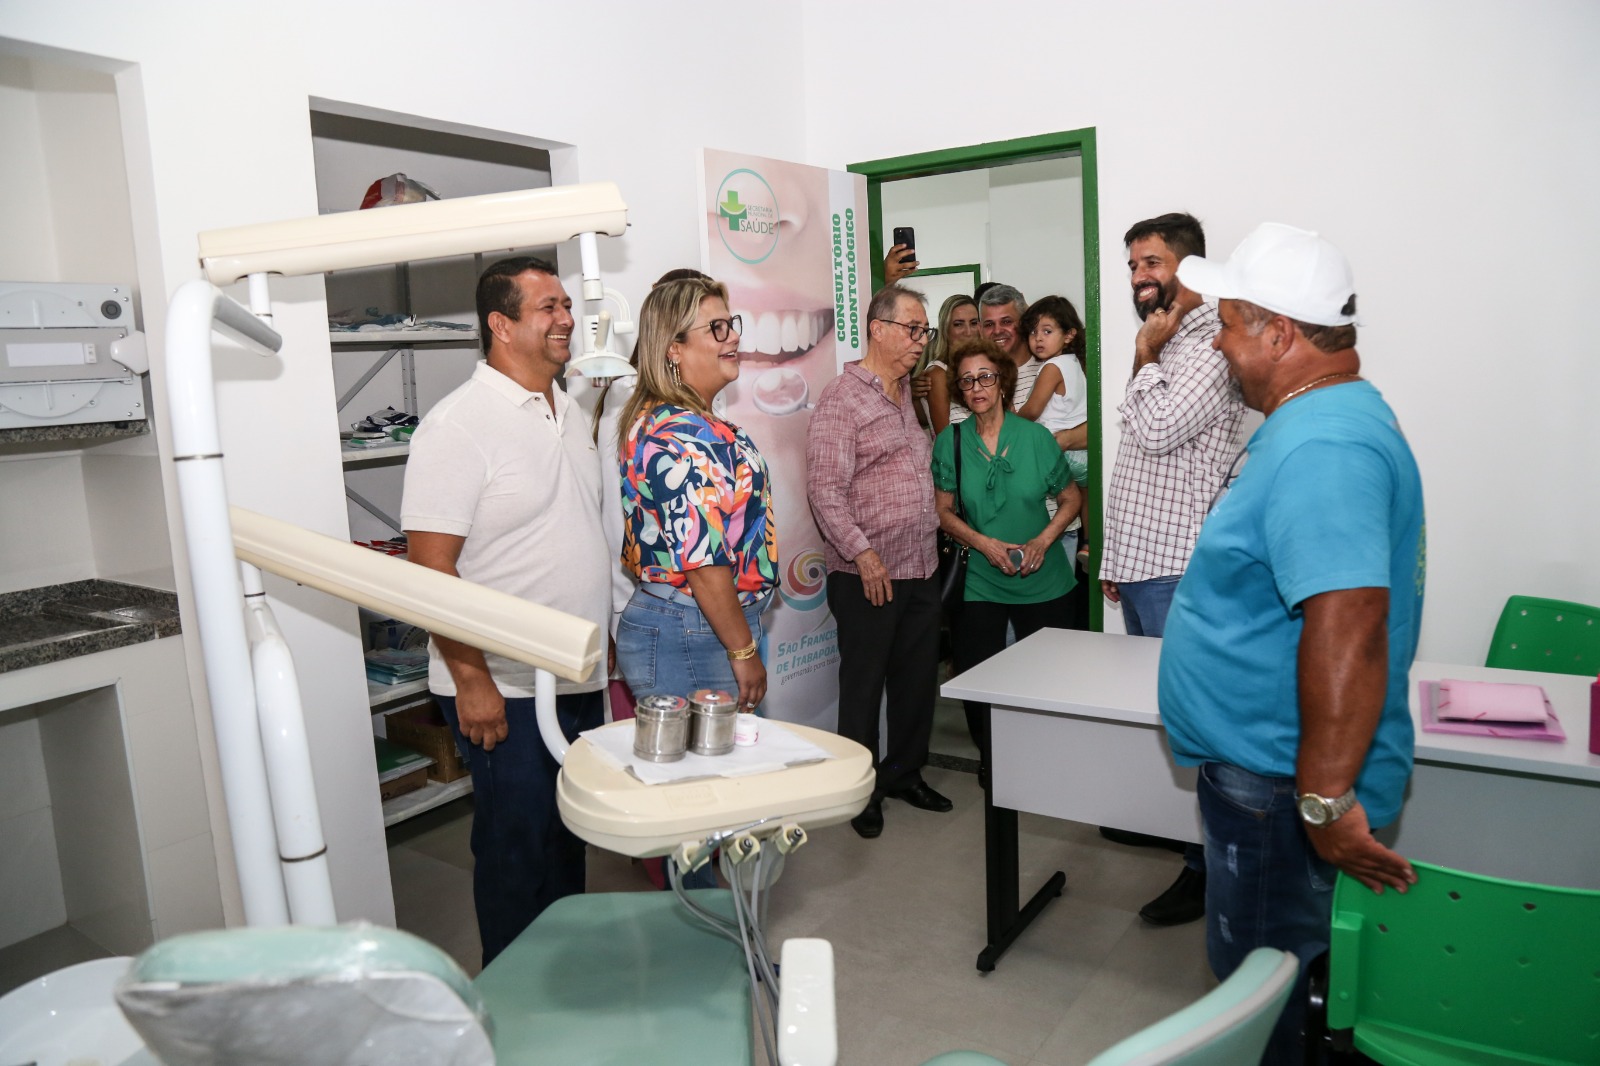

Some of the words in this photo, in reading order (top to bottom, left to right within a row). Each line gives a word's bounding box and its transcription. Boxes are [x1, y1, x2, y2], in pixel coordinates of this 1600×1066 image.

[740, 218, 774, 235] SAÚDE
[832, 213, 846, 342] CONSULTÓRIO
[845, 208, 859, 349] ODONTOLÓGICO
[800, 629, 838, 650] FRANCIS
[776, 661, 789, 675] DE
[813, 661, 826, 672] para
